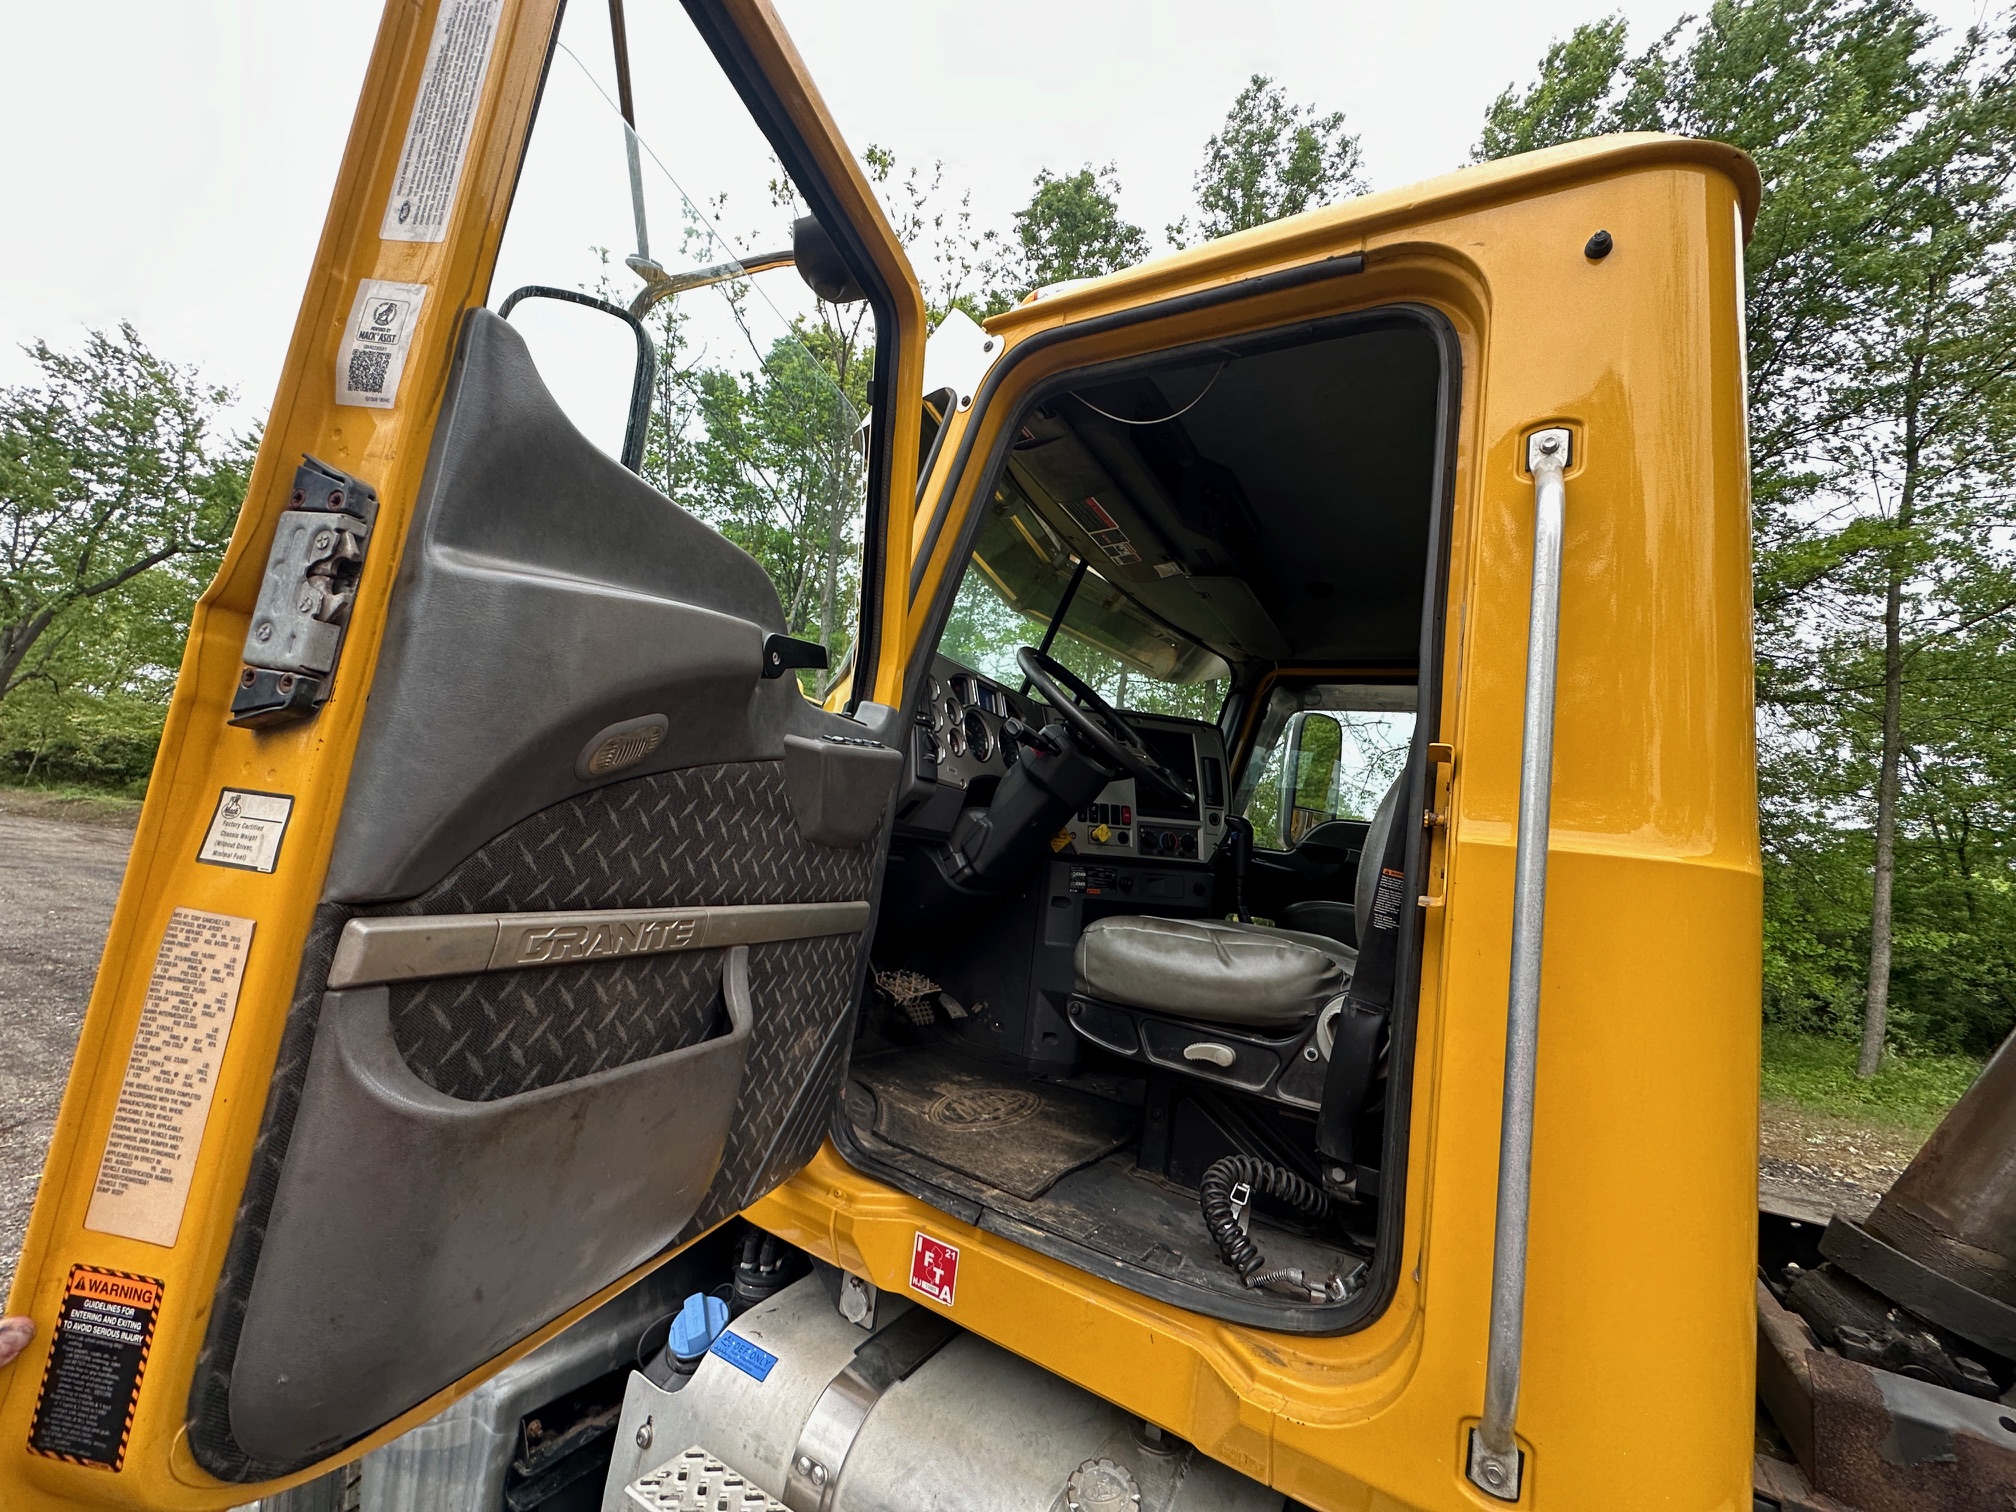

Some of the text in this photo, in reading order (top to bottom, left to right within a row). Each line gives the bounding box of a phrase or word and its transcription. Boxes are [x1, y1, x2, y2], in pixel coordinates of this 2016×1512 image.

[378, 333, 397, 343] ASIST
[224, 806, 239, 814] Mack
[222, 820, 264, 831] Factory Certified
[240, 833, 257, 841] Weight
[214, 840, 253, 851] (Without Driver,
[515, 920, 695, 963] GRANITE
[128, 1090, 156, 1100] ACCORDANCE
[135, 1083, 153, 1091] VEHICLE
[176, 1090, 201, 1100] COMPLETED
[168, 1106, 183, 1114] WHERE
[156, 1113, 173, 1121] VEHICLE
[115, 1115, 140, 1124] CONFORMS
[157, 1123, 181, 1132] APPLICABLE
[113, 1123, 184, 1142] FEDERAL MOTOR VEHICLE SAFETY
[108, 1140, 121, 1148] THEFT
[123, 1143, 149, 1153] PREVENTION
[150, 1139, 168, 1148] BUMPER
[114, 1158, 132, 1166] AUGUST
[140, 1155, 155, 1163] EFFECT
[102, 1164, 120, 1172] VEHICLE
[121, 1168, 153, 1178] IDENTIFICATION
[98, 1178, 116, 1186] VEHICLE
[96, 1186, 123, 1196] DUMP BODY
[945, 1249, 955, 1260] 21
[912, 1276, 922, 1287] NJ
[87, 1280, 153, 1302] WARNING
[83, 1299, 135, 1316] GUIDELINES FOR
[70, 1309, 141, 1330] ENTERING AND EXITING
[63, 1320, 143, 1343] TO AVOID SERIOUS INJURY
[734, 1343, 749, 1354] DEF
[750, 1353, 771, 1367] ONLY
